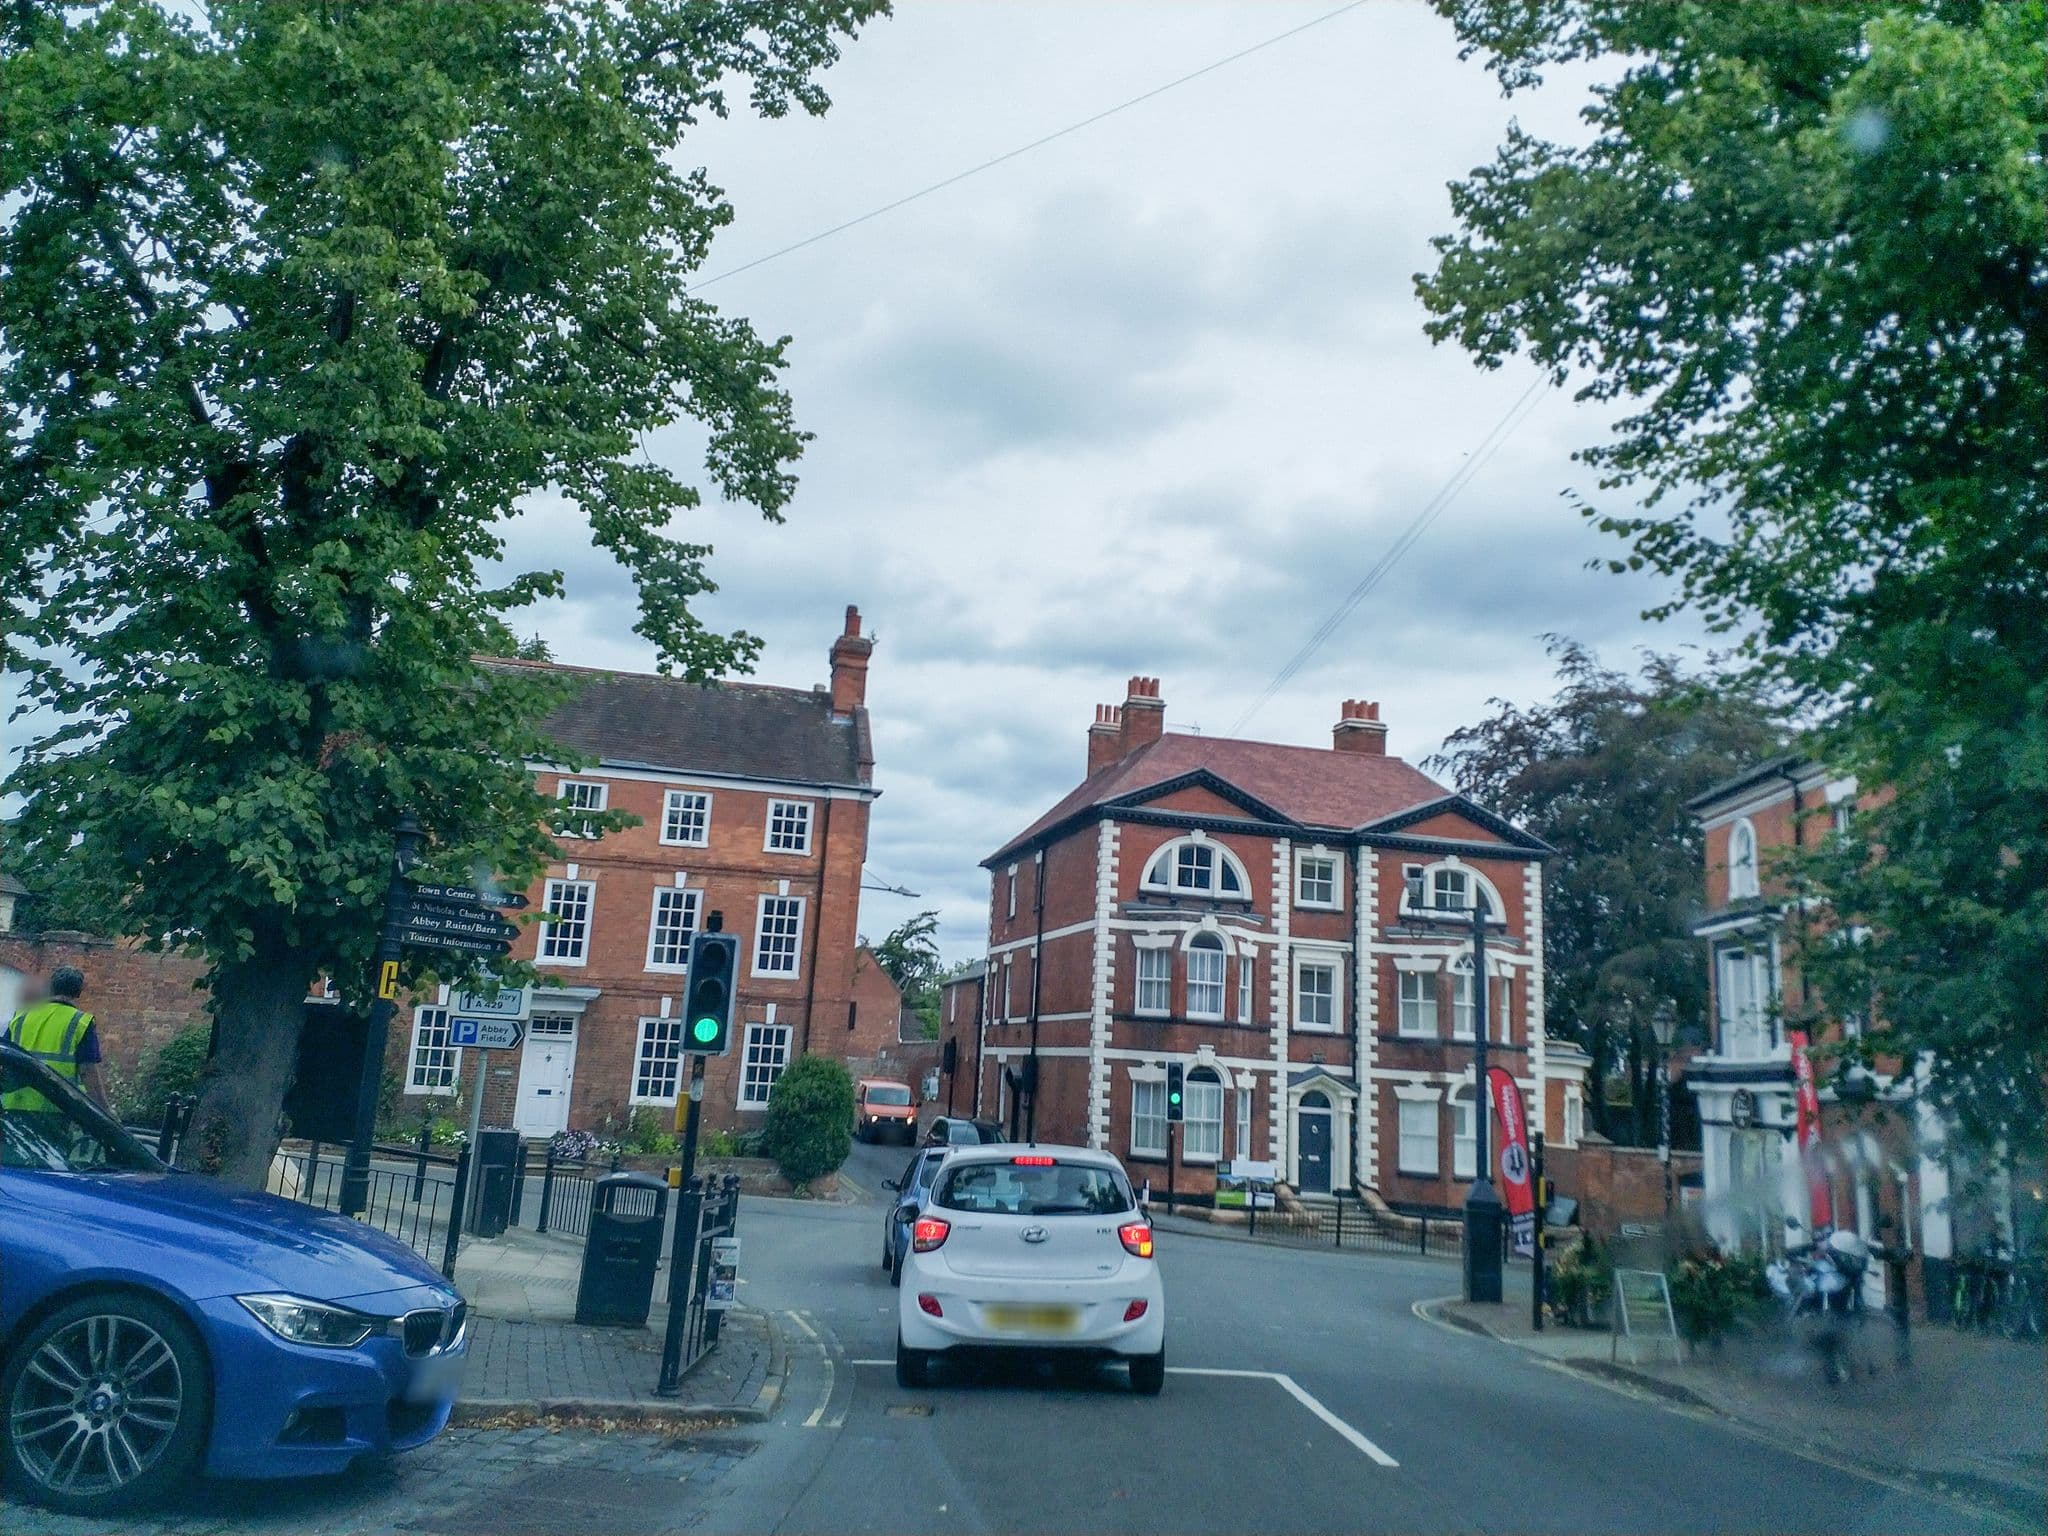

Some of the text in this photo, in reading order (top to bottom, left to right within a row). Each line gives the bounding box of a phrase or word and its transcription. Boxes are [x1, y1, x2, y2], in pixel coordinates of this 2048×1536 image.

[417, 885, 507, 905] Town Centre Shops
[411, 901, 486, 920] St Nicholas Church
[411, 916, 497, 934] Abbey Ruins/Barn
[409, 931, 492, 950] Tourist Information
[458, 1022, 476, 1042] P
[481, 1024, 509, 1035] Abbey
[481, 1034, 507, 1043] Fields
